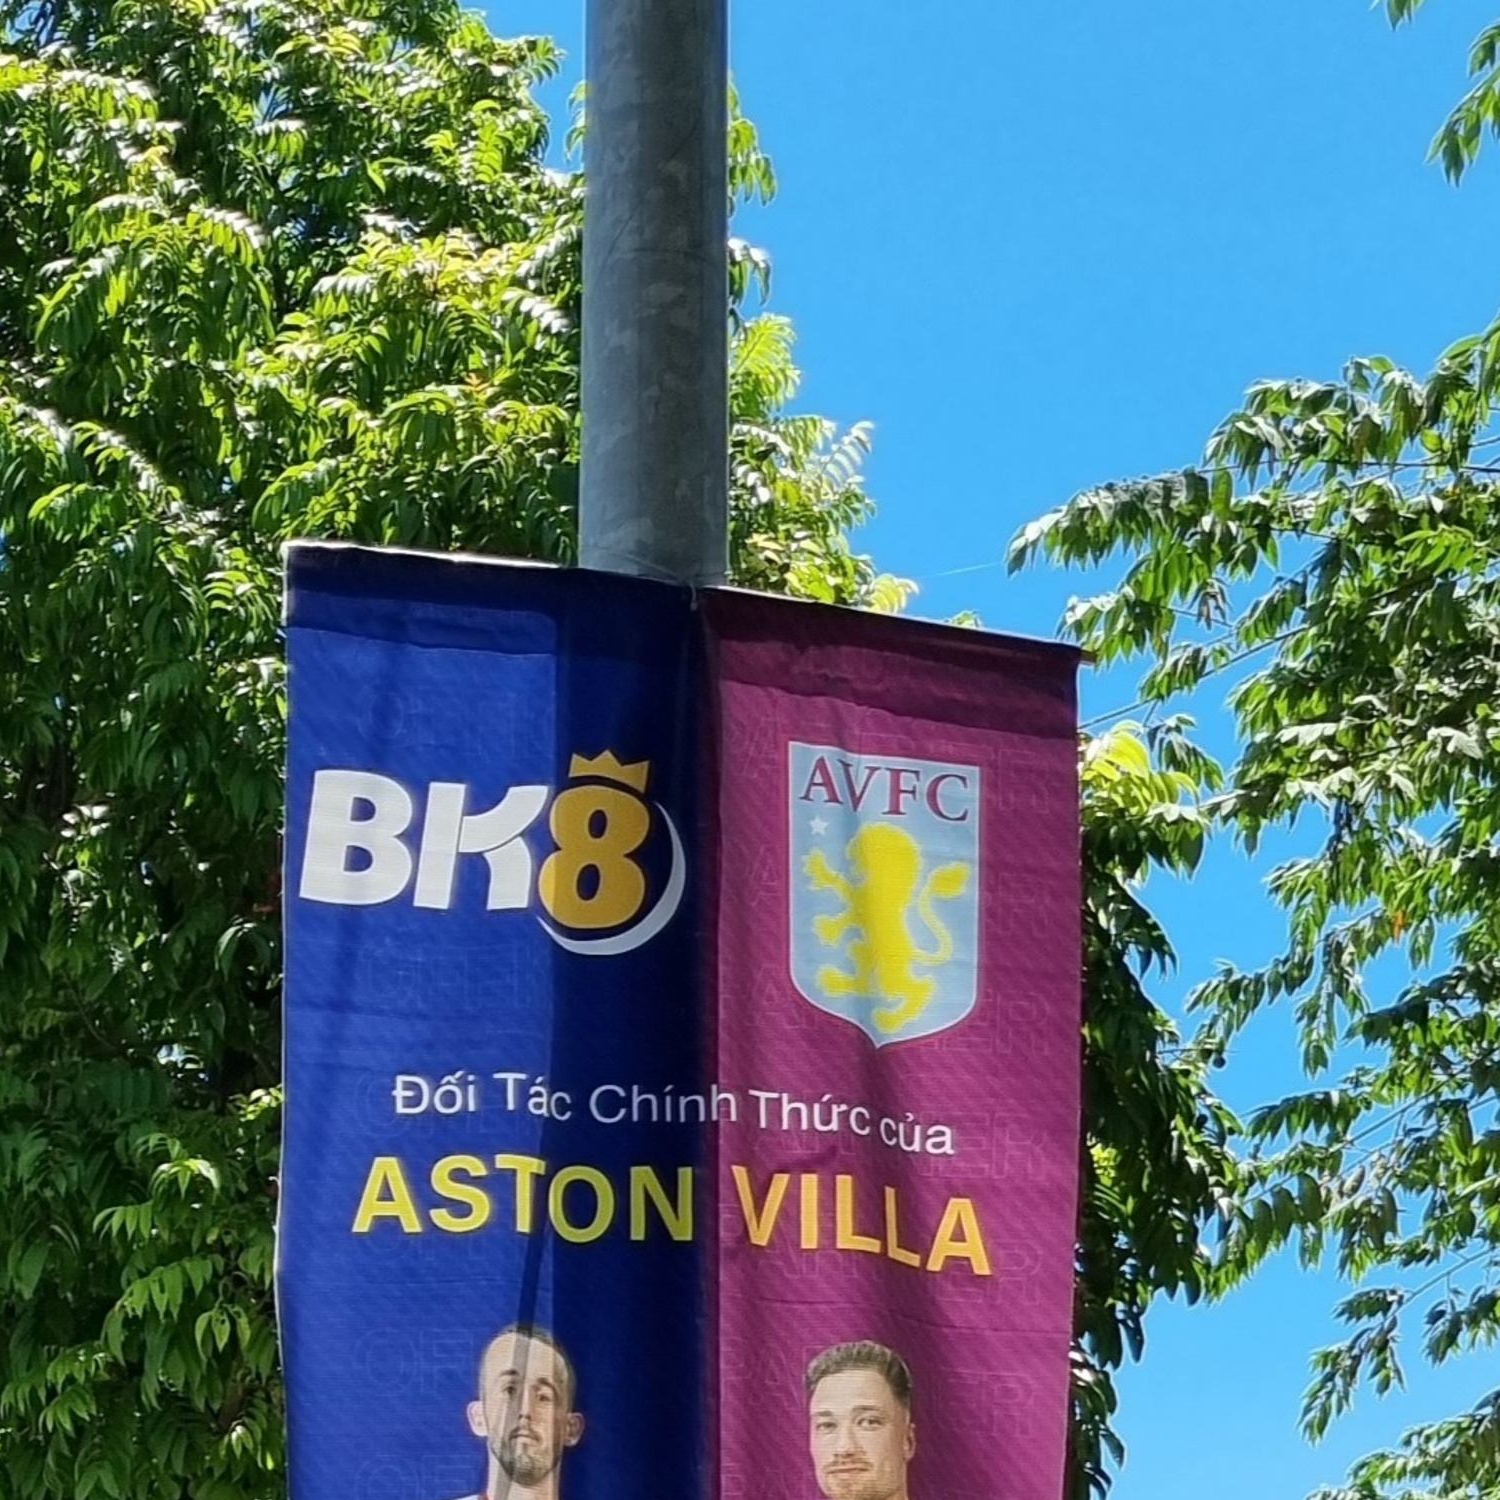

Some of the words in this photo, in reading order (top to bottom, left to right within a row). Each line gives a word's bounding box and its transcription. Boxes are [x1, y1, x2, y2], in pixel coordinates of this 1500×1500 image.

[799, 755, 969, 823] AVFC
[299, 768, 653, 932] BK8
[391, 1070, 477, 1115] Đối
[493, 1072, 573, 1122] Tác
[588, 1084, 737, 1126] Chính
[749, 1089, 871, 1136] Thức
[880, 1111, 956, 1155] của
[350, 1153, 694, 1244] ASTON
[730, 1164, 993, 1277] VILLA
